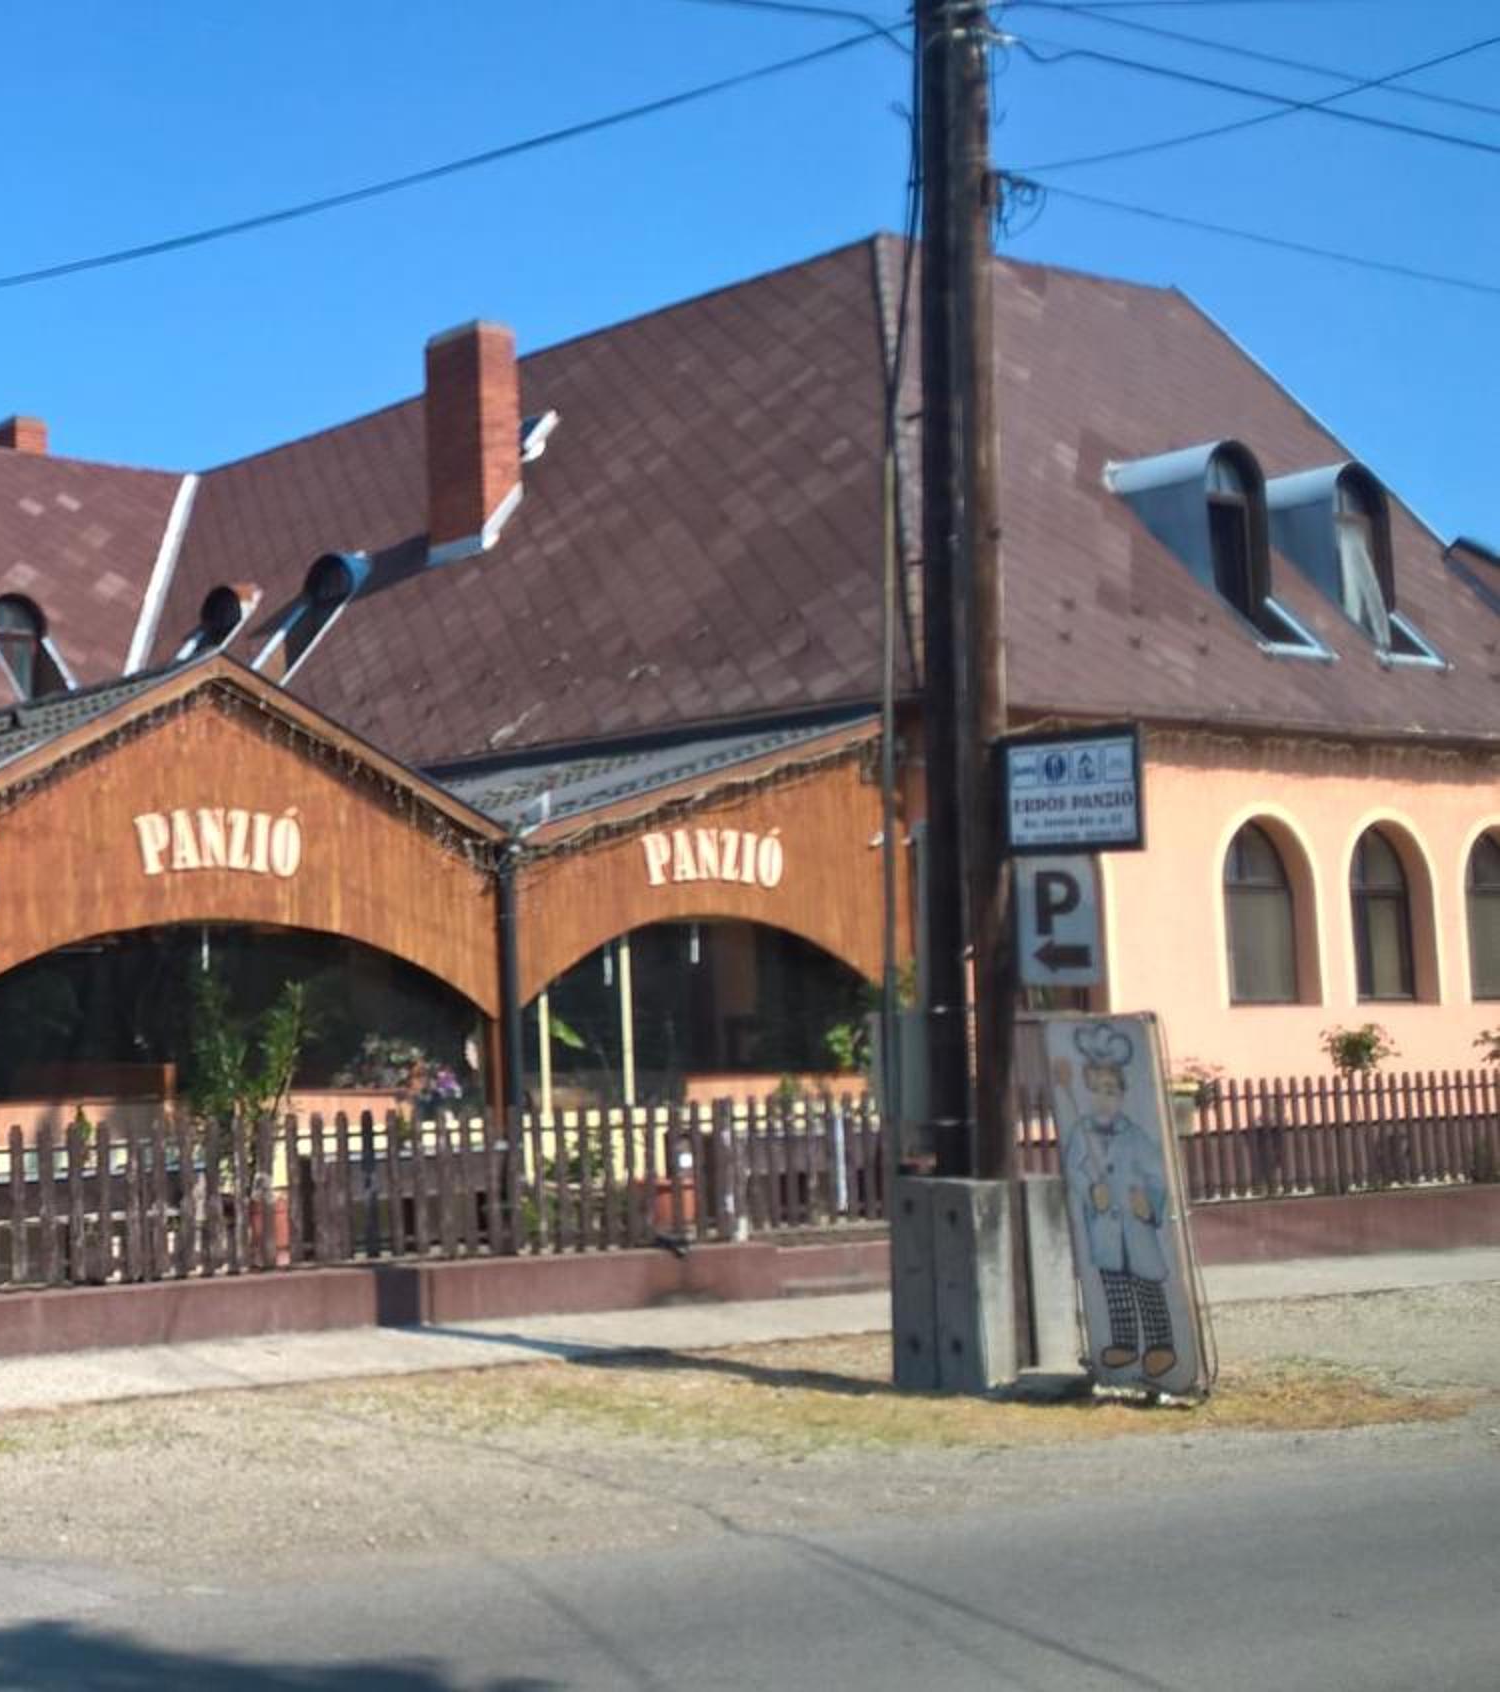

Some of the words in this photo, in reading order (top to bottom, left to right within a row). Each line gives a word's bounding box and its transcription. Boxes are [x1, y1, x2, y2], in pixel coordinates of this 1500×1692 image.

[133, 805, 301, 877] PANZIÓ
[641, 827, 783, 888] PANZIÓ
[1035, 870, 1081, 936] P
